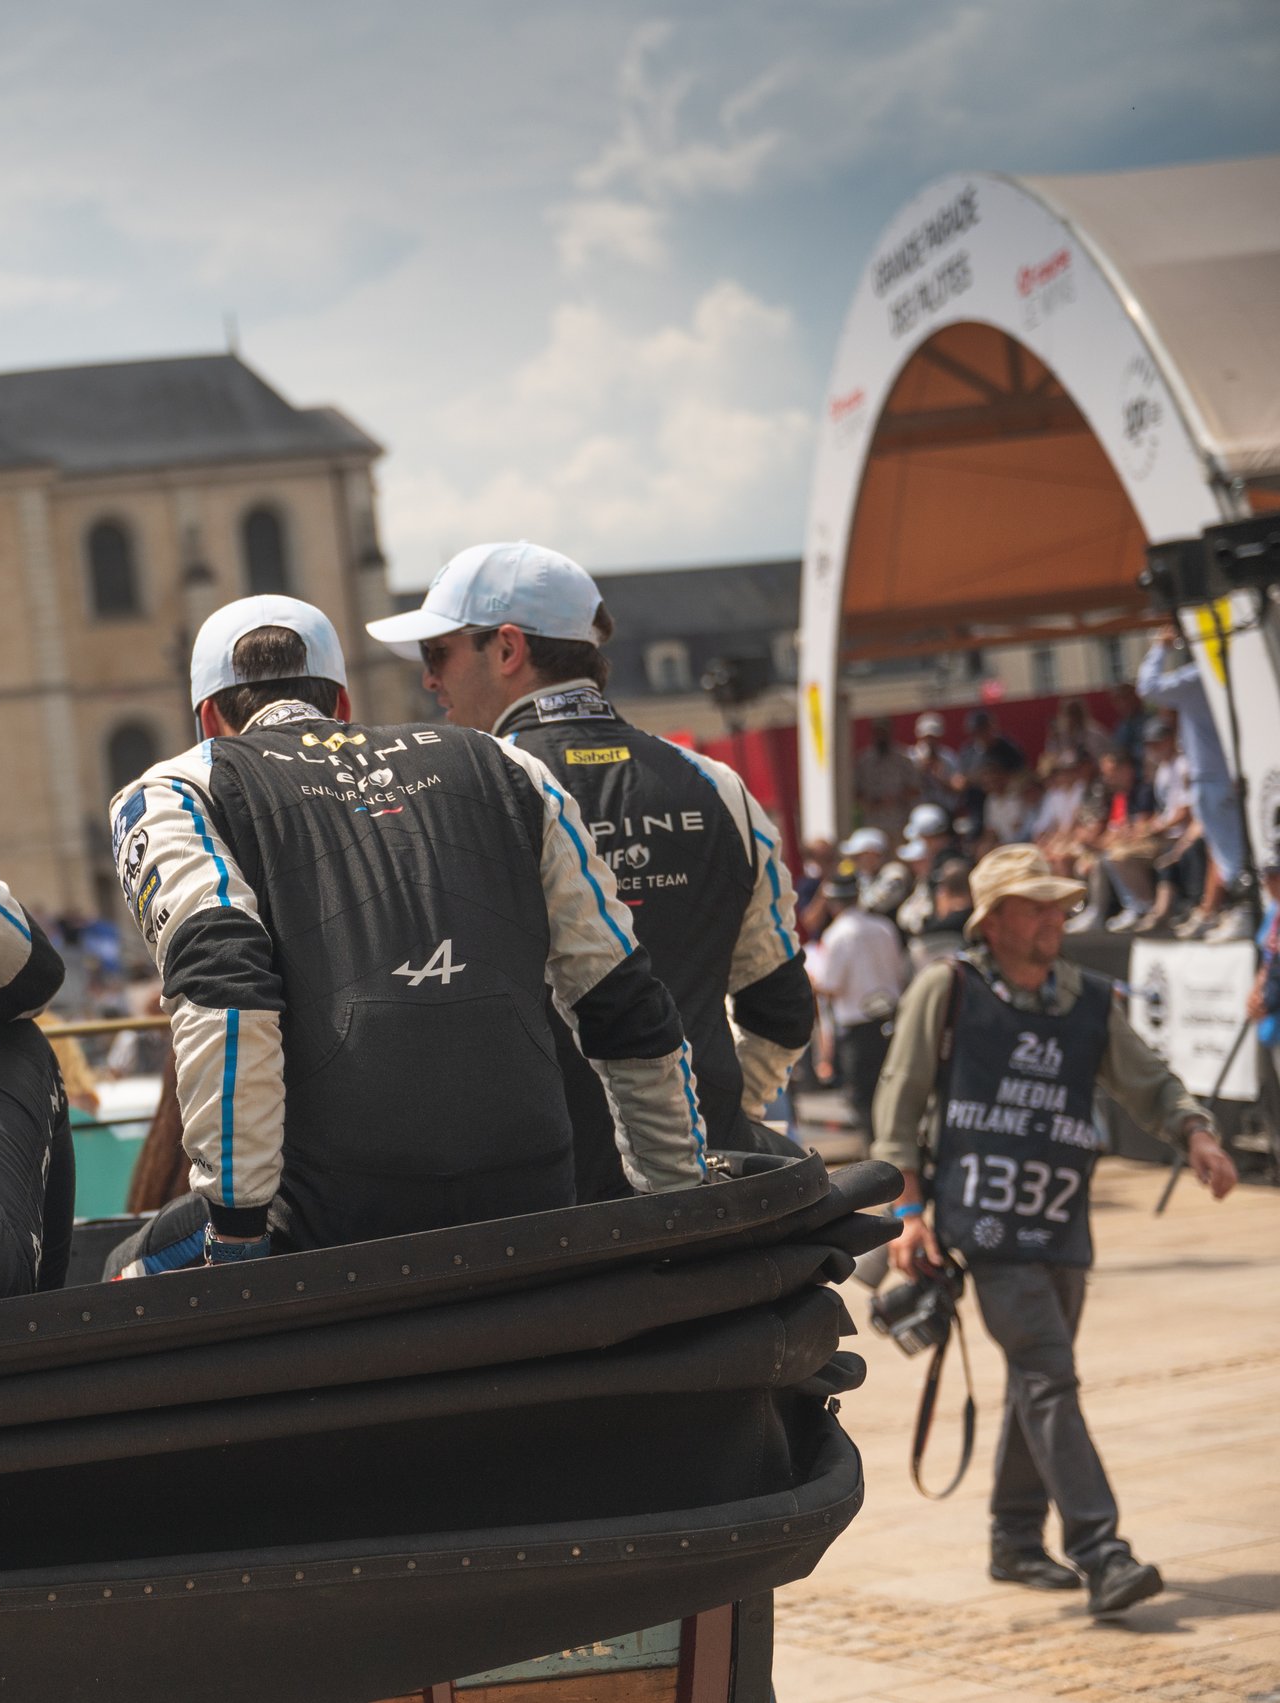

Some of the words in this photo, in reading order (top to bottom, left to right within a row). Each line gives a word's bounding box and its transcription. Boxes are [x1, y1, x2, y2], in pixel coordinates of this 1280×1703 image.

[573, 750, 621, 764] Sabelt
[301, 785, 397, 807] ENDURNCE
[397, 774, 442, 796] TEAM
[589, 811, 704, 842] PINE
[646, 873, 689, 889] TEAM
[995, 1076, 1069, 1113] MEDIA
[946, 1099, 1033, 1136] PITLANE
[960, 1153, 1082, 1223] 1332
